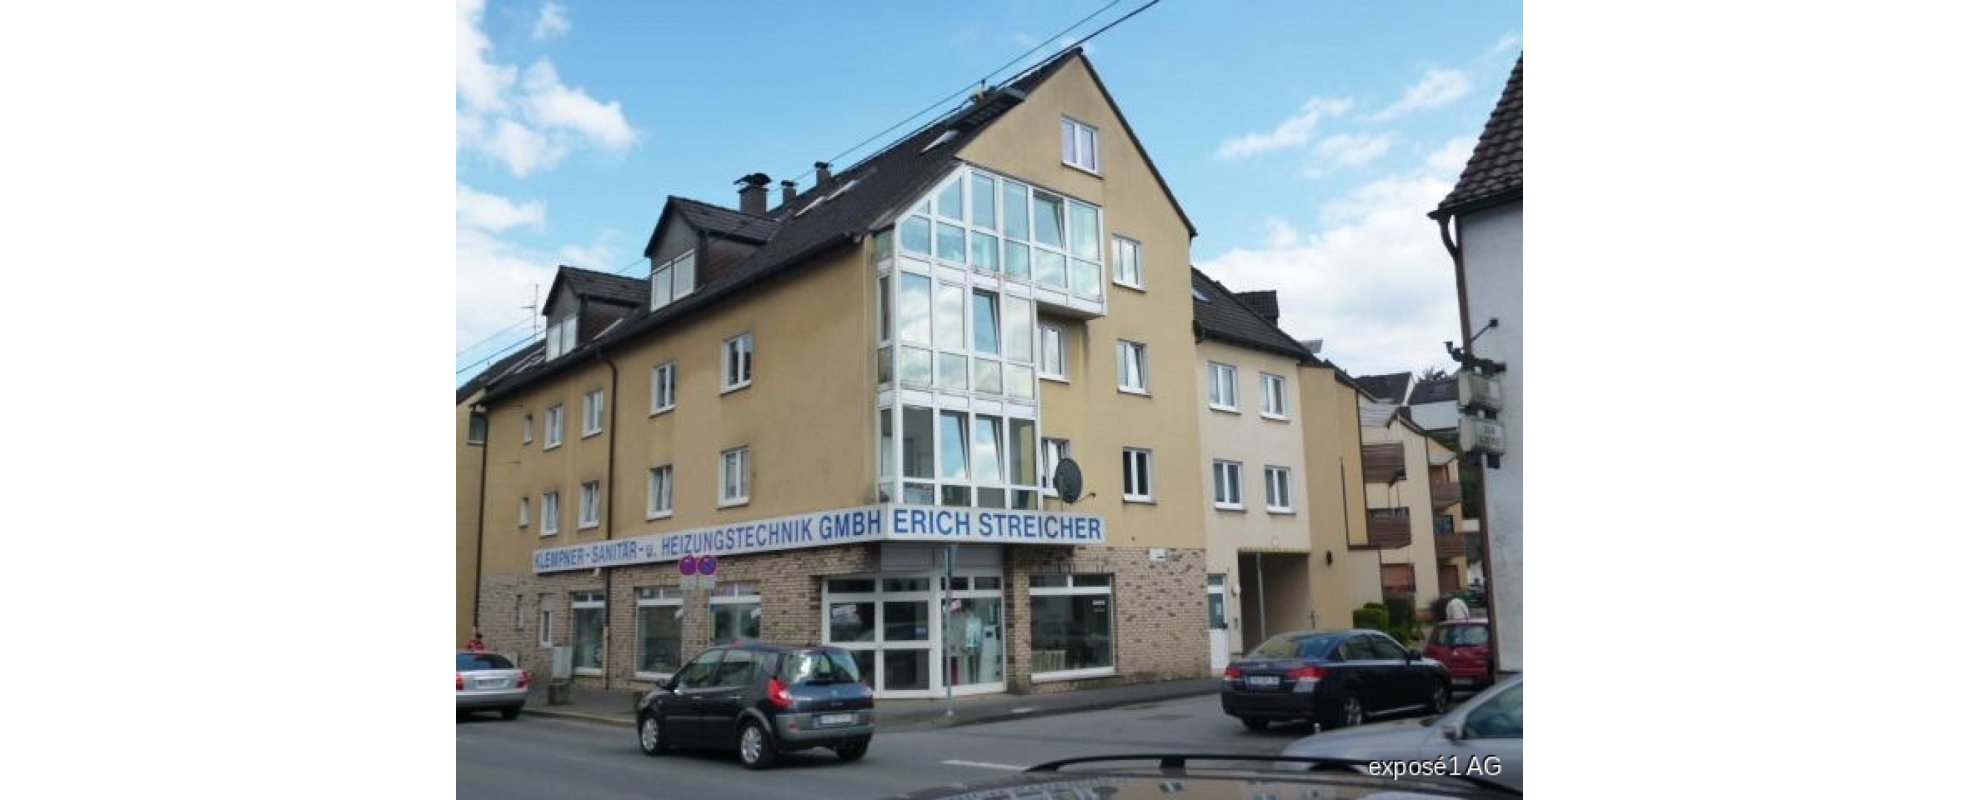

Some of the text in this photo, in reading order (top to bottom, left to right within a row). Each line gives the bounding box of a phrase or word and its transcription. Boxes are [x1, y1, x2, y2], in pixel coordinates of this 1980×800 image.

[661, 516, 813, 557] HEIZUNGSTECHNIK
[819, 509, 882, 540] GMBH
[893, 509, 1101, 540] ERICH STREICHER
